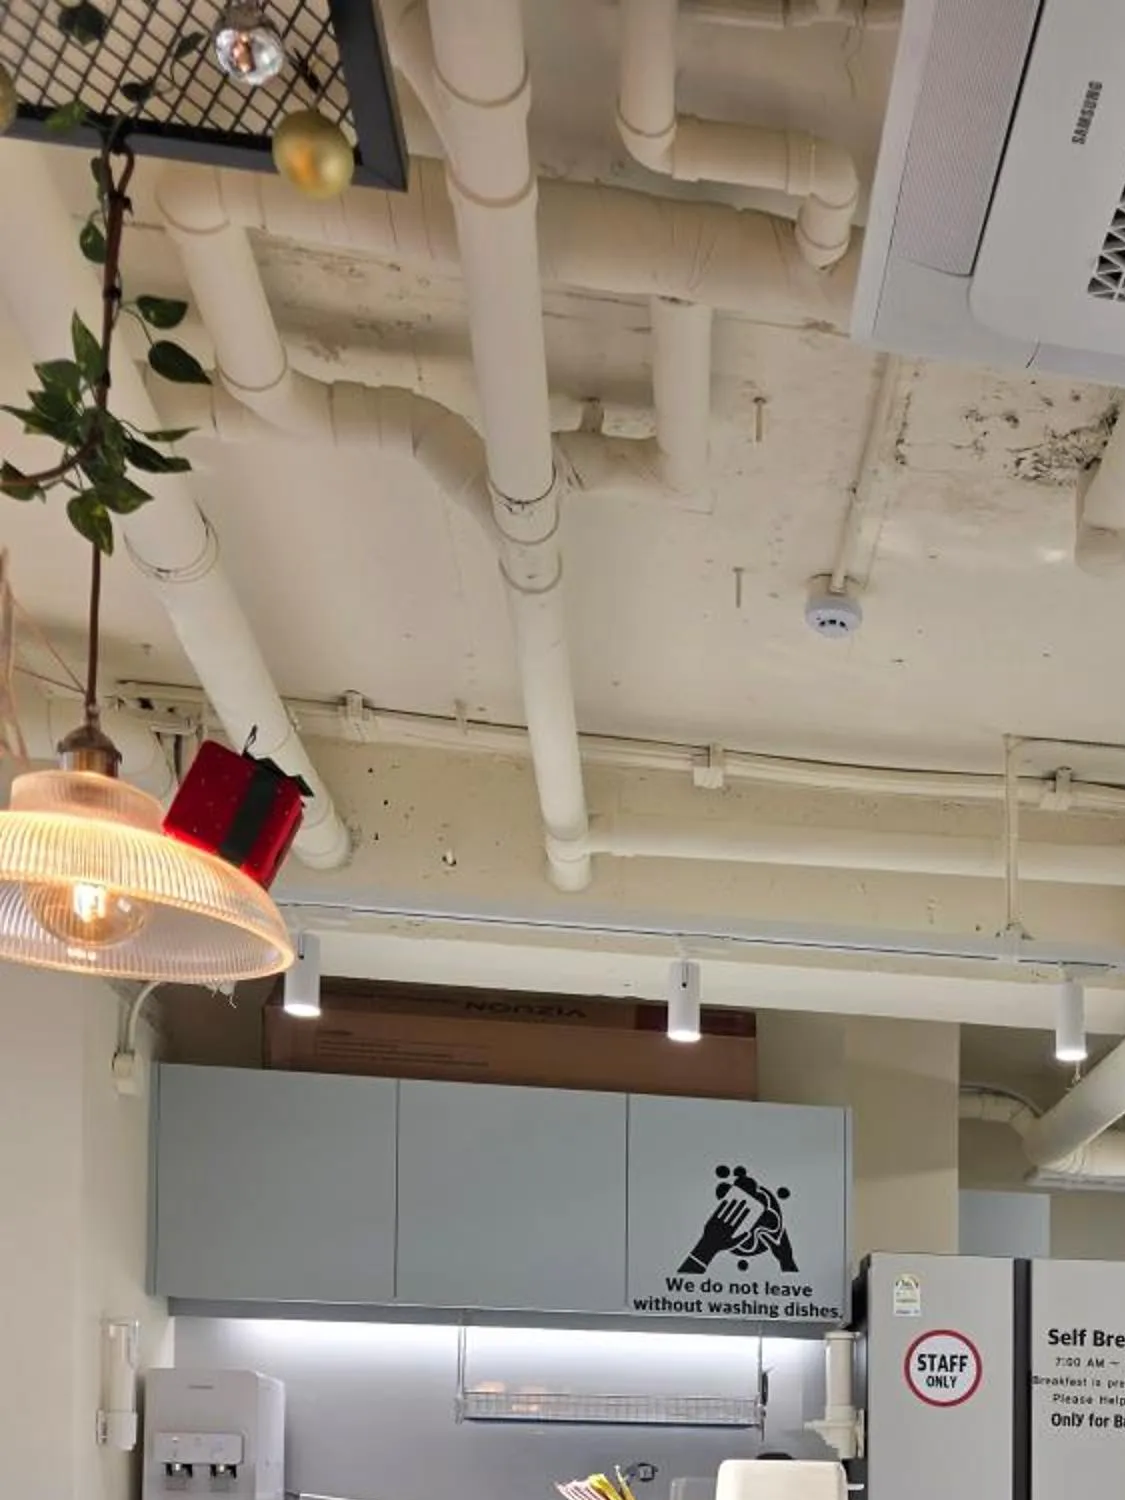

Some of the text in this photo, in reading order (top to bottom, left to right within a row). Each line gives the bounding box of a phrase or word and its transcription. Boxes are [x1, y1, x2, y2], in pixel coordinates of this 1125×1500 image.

[666, 1277, 813, 1297] We do not leave
[633, 1296, 843, 1319] without washing dishes.
[1048, 1328, 1087, 1346] Self
[917, 1354, 968, 1372] STAFF
[1087, 1358, 1105, 1369] AM
[926, 1376, 957, 1389] ONLY
[1052, 1394, 1092, 1405] Please
[1089, 1413, 1110, 1428] for
